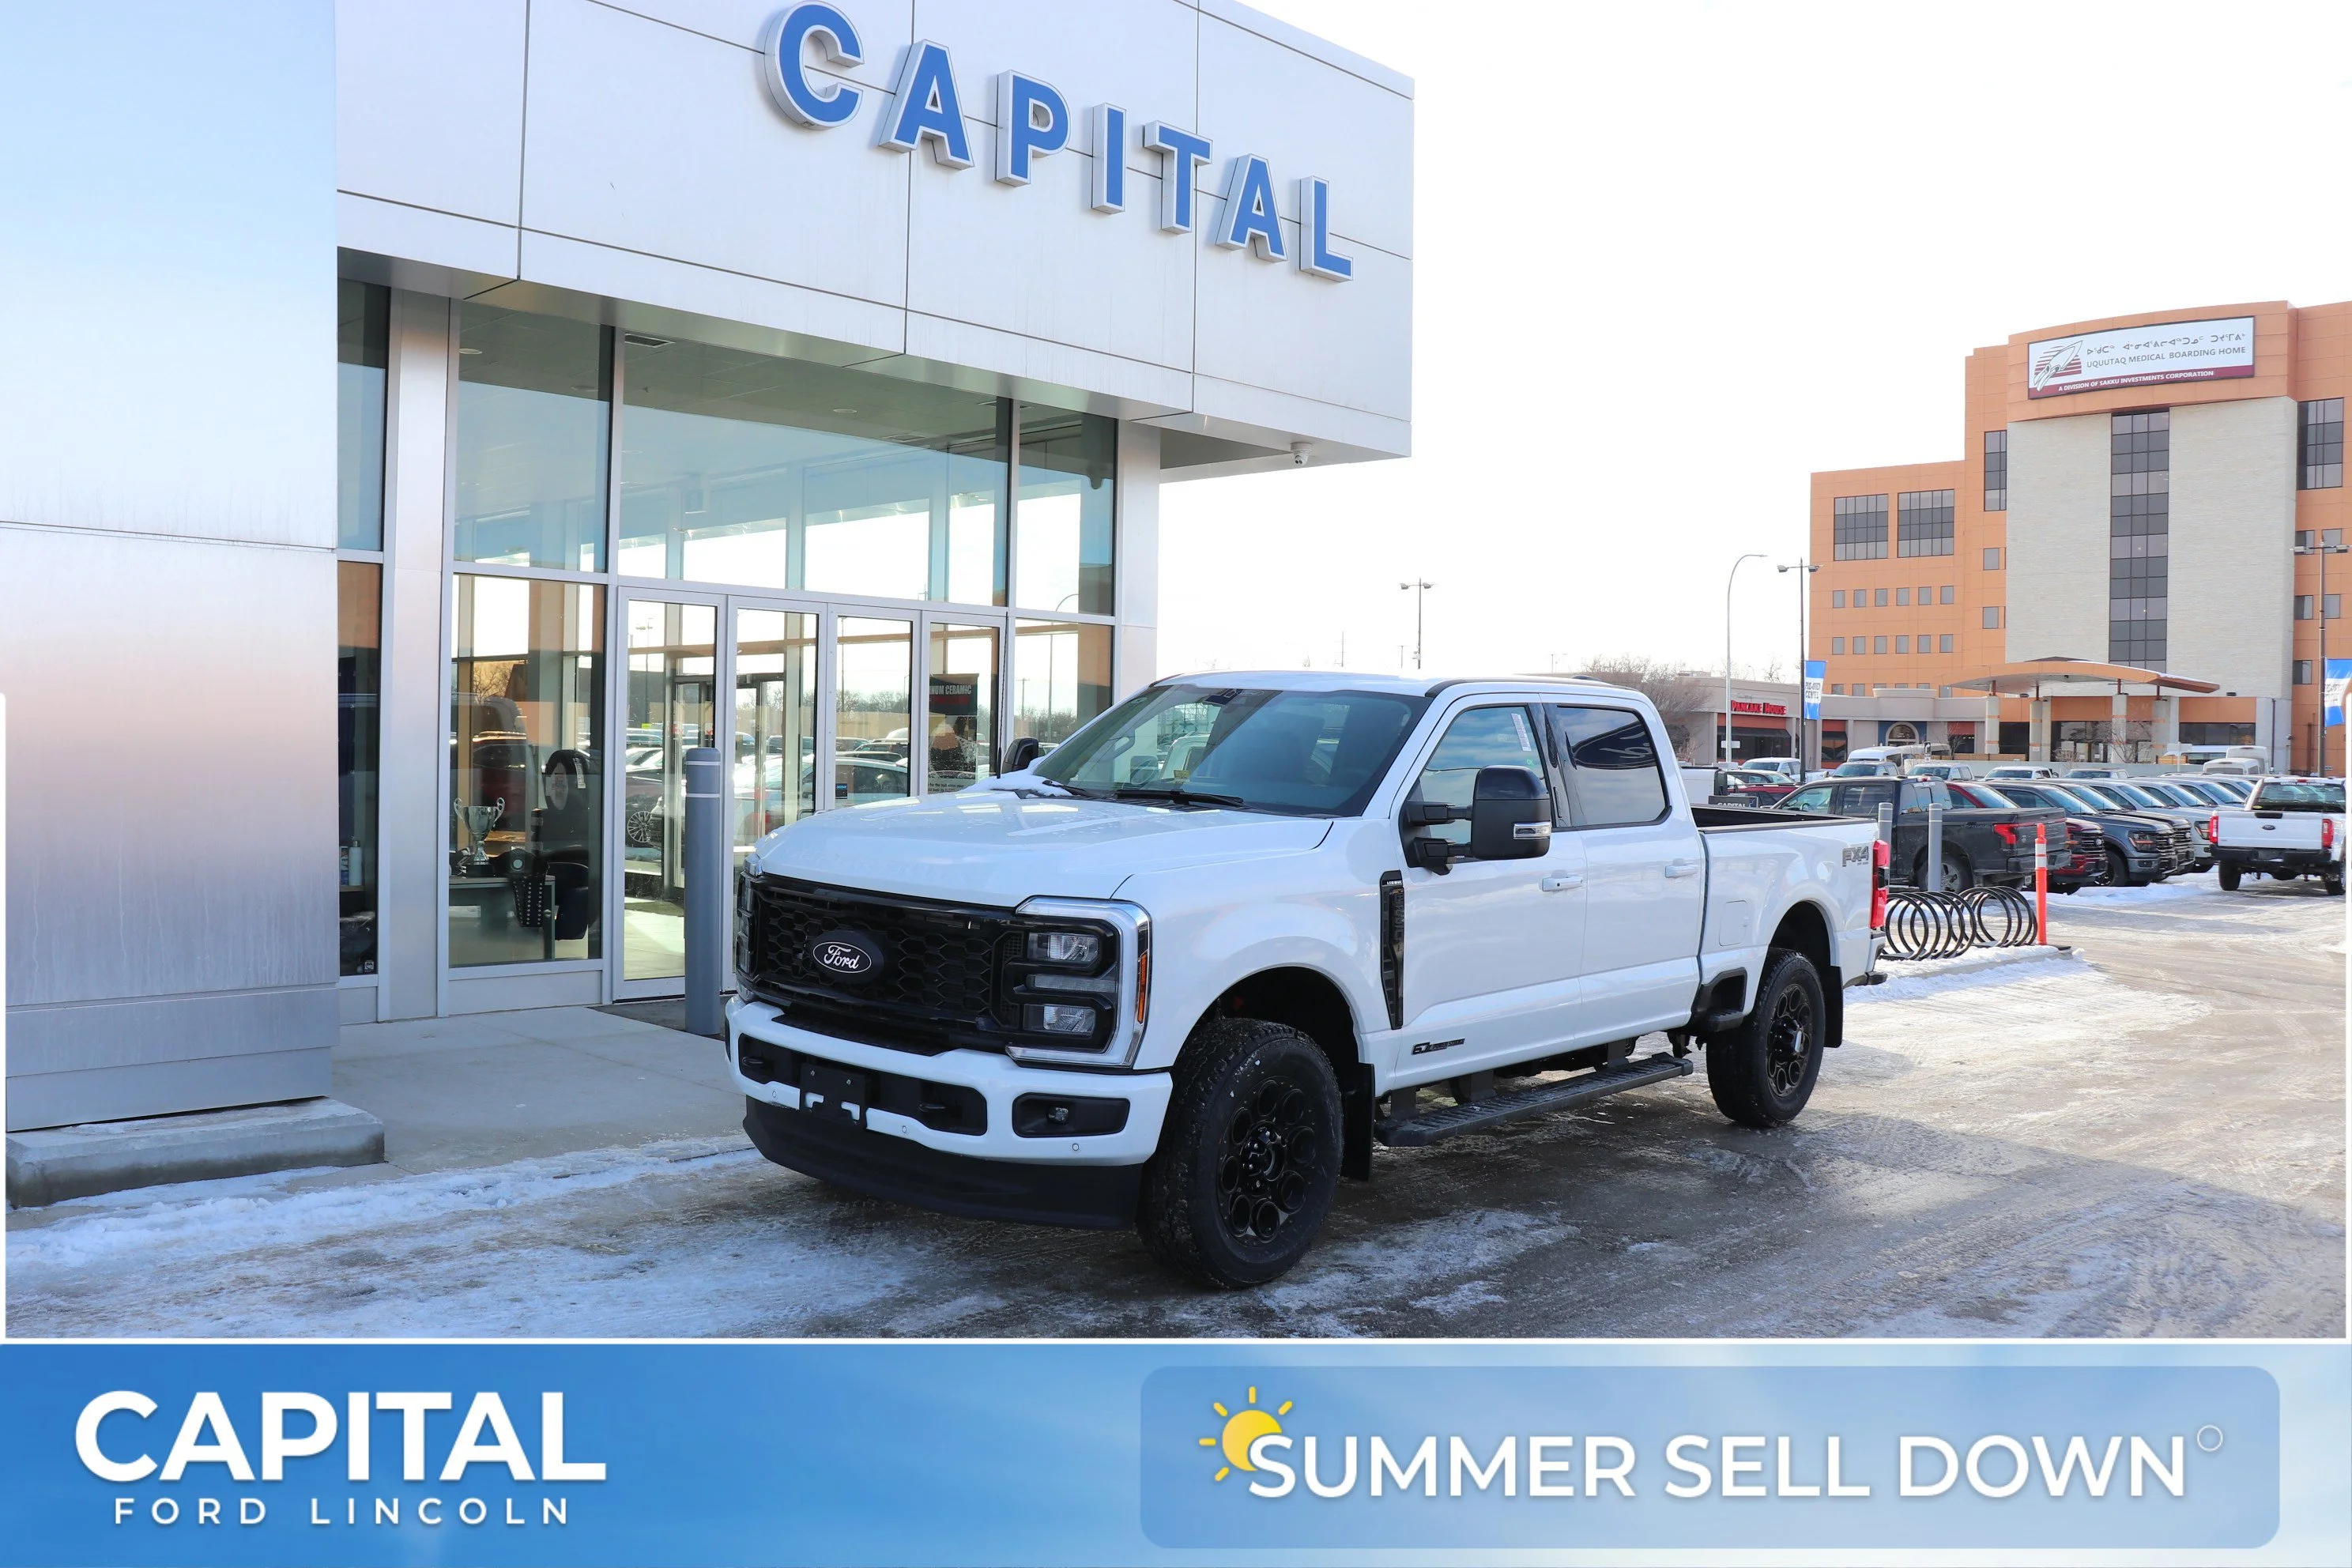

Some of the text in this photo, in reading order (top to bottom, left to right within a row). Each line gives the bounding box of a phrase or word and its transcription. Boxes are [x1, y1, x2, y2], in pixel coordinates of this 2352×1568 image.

[765, 2, 1353, 282] CAPITAL
[2086, 357, 2126, 368] UQUUTAQ
[2128, 353, 2165, 363] MEDICAL
[2169, 349, 2216, 359] BOARDING
[2064, 382, 2090, 391] DIVISION
[2120, 375, 2164, 384] INVESTMENTS
[2165, 371, 2214, 379] CORPORATION
[945, 684, 971, 695] CERAMIC
[1842, 846, 1869, 867] FX4
[824, 944, 860, 969] Ford
